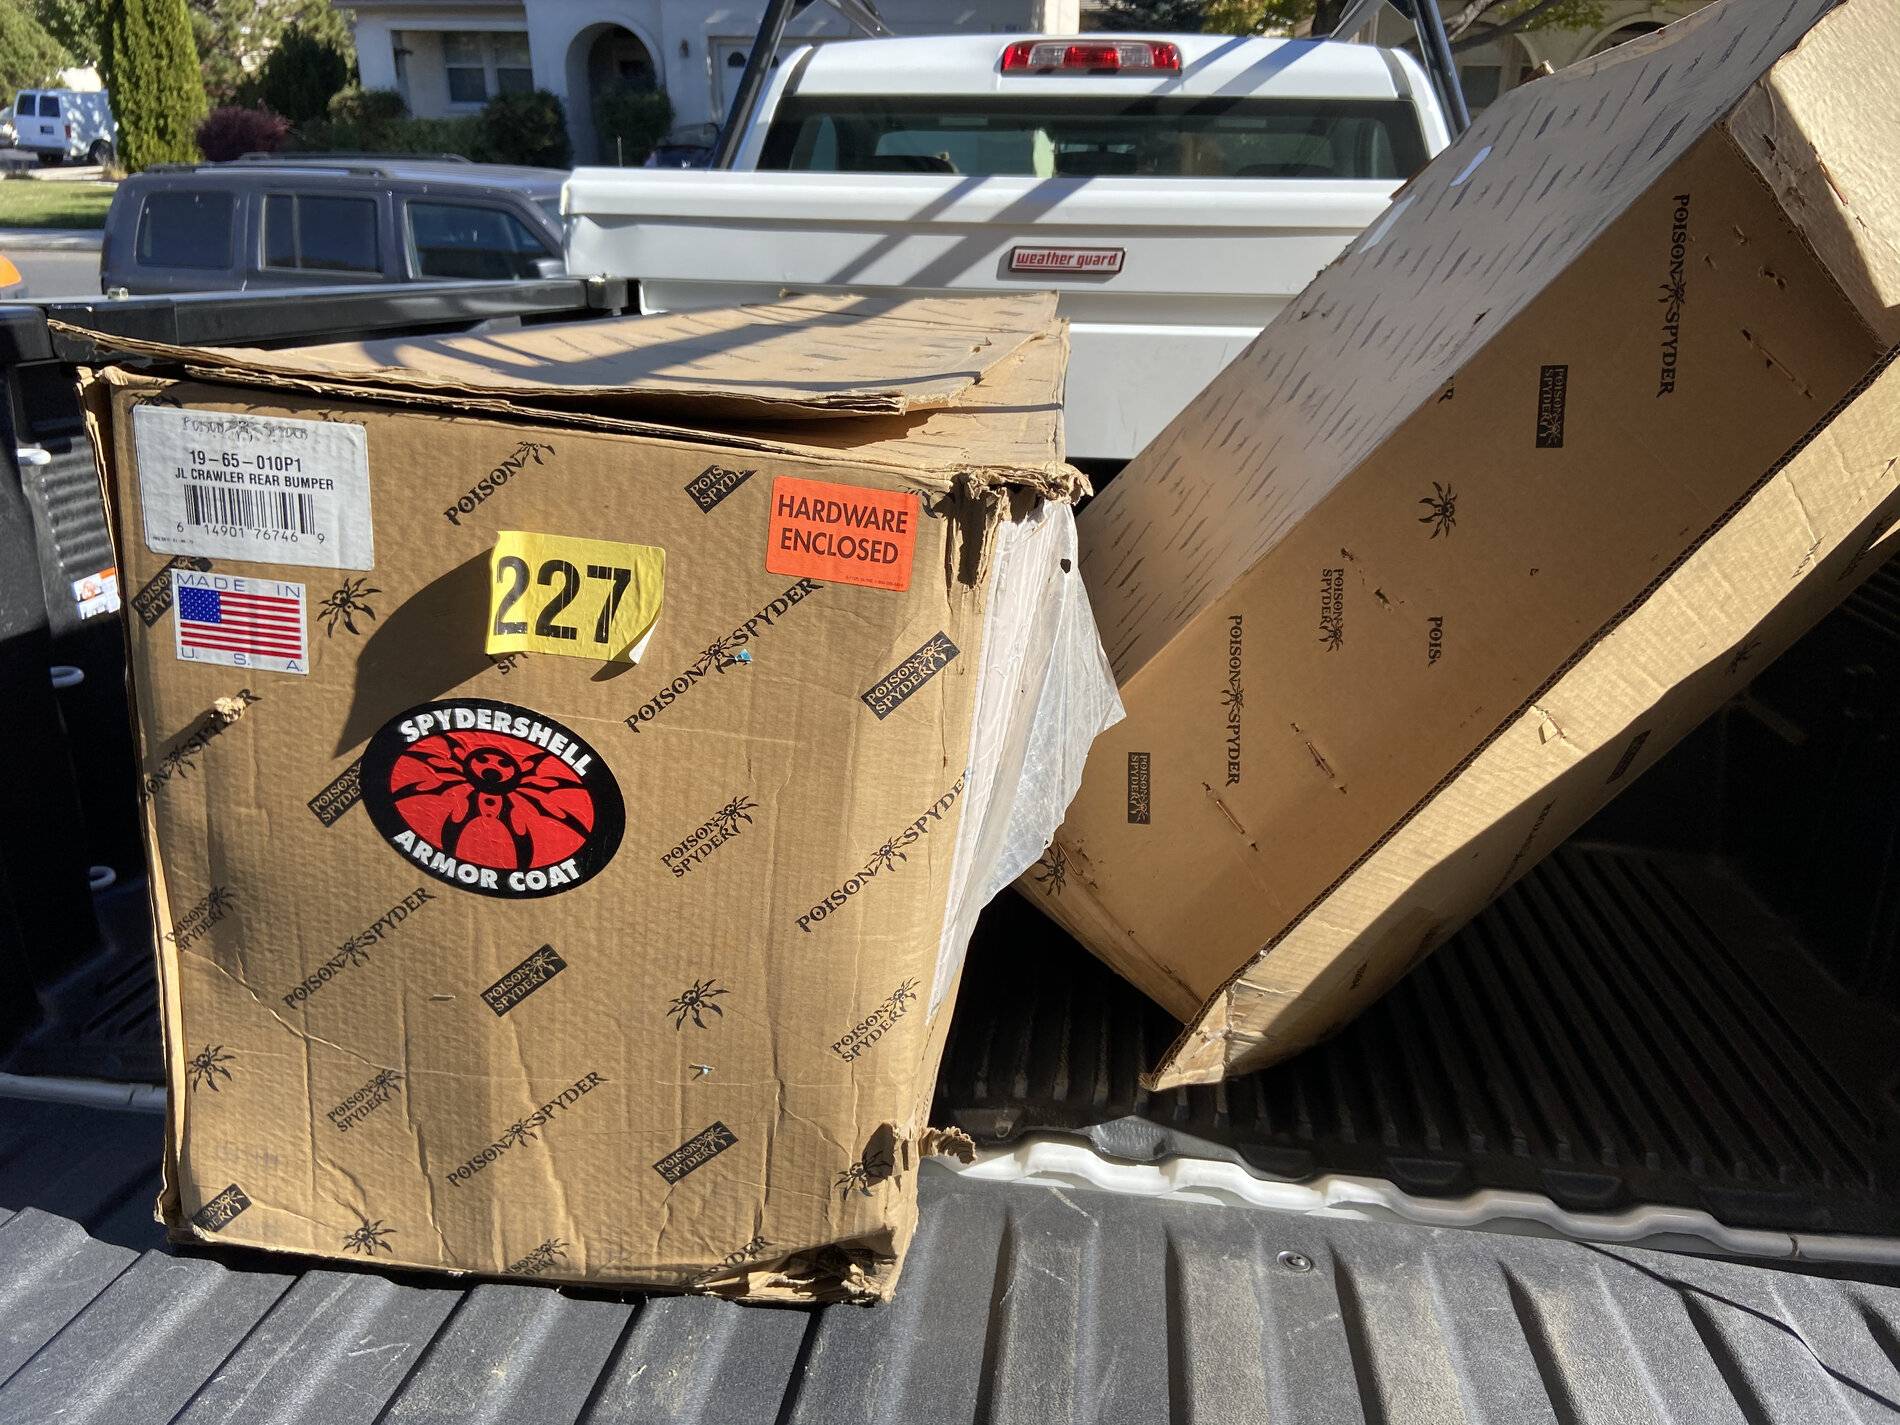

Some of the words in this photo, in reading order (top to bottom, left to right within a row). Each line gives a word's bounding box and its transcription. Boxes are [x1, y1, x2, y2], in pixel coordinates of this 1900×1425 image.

[1016, 252, 1074, 266] weather
[1077, 253, 1117, 268] guard
[1670, 193, 1690, 280] POISON
[1656, 308, 1680, 398] SPYDER
[1541, 369, 1553, 423] SPYDER
[1553, 368, 1564, 417] POISON
[175, 468, 187, 479] JL
[191, 469, 244, 484] CRAWLER
[249, 473, 280, 487] REAR
[285, 477, 334, 490] BUMPER
[443, 455, 524, 526] POISON
[177, 522, 184, 533] 6
[204, 524, 244, 538] 14901
[254, 529, 298, 542] 76746
[318, 533, 326, 544] 9
[777, 494, 908, 534] HARDWARE
[780, 527, 899, 565] ENCLOSED
[176, 572, 245, 592] MADE
[276, 583, 300, 599] IN
[493, 555, 632, 644] 227
[1320, 568, 1332, 626] SPYDER
[1333, 568, 1344, 624] POISON
[624, 661, 705, 733] POISON
[732, 577, 824, 646] SPYDER
[1228, 615, 1243, 684] POISON
[866, 659, 919, 705] POISON
[875, 666, 934, 714] SPYDER
[400, 708, 593, 777] SPYDERSHELL
[1226, 710, 1241, 787] SPYDER
[311, 772, 357, 812] POISON
[1130, 755, 1140, 801] SPYDER
[1140, 755, 1148, 799] POISON
[394, 830, 499, 890] ARMOR
[509, 858, 581, 891] COAT
[660, 818, 719, 868] POISON
[672, 827, 738, 878] SPYDER
[795, 866, 877, 933] POISON
[282, 958, 346, 1010] POISON
[358, 887, 437, 946] SPYDER
[485, 967, 530, 1003] POISON
[494, 973, 544, 1011] SPYDER
[831, 1004, 889, 1054] POISON
[842, 1011, 905, 1062] SPYDER
[327, 1085, 373, 1122] POISON
[337, 1093, 389, 1132] SPYDER
[445, 1139, 511, 1187] POISON
[532, 1071, 610, 1126] SPYDER
[657, 1142, 701, 1173] POISON
[665, 1147, 714, 1180] SPYDER
